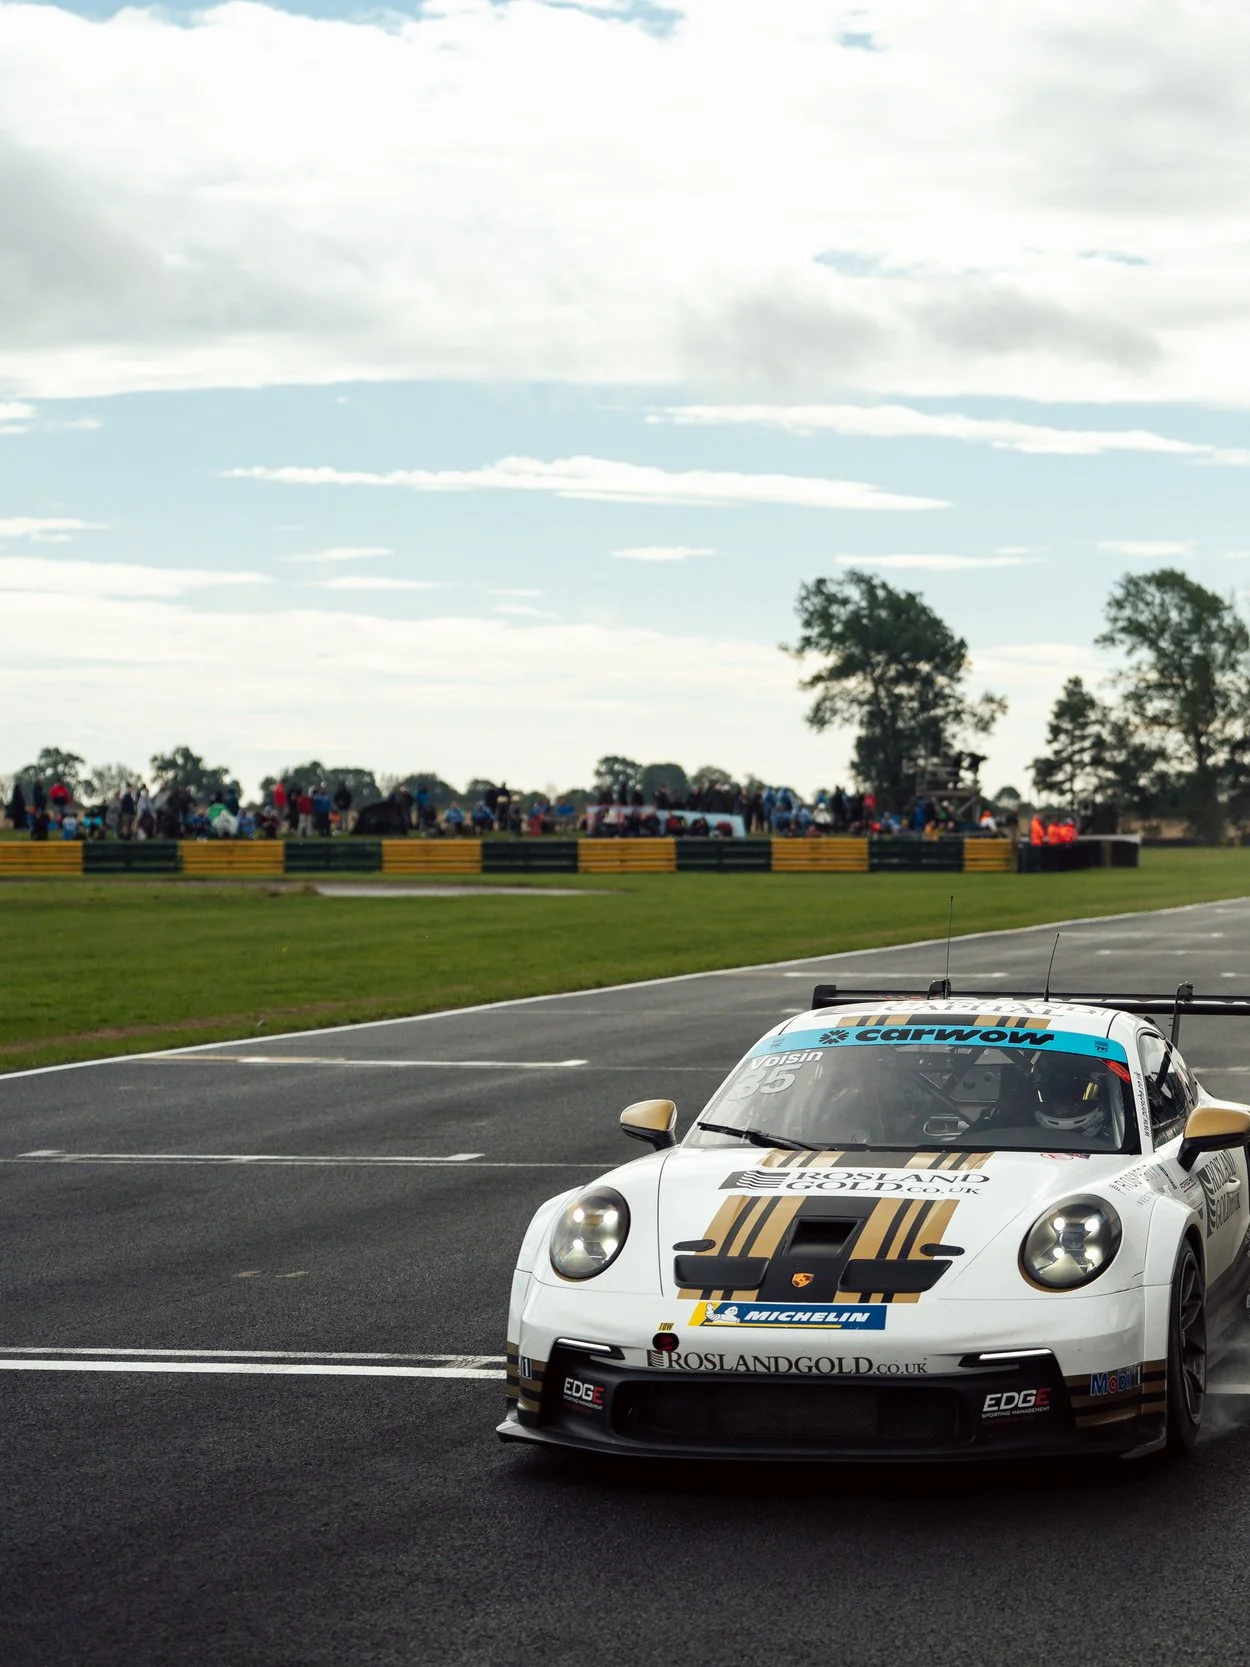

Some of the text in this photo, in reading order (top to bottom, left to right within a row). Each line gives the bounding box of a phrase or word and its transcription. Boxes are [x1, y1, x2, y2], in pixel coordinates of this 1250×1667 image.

[855, 1027, 1055, 1046] carwow
[751, 1049, 824, 1070] Voisin
[794, 1170, 991, 1184] ROSLAND
[743, 1311, 872, 1323] MICHELIN
[563, 1377, 604, 1404] EDGE
[1090, 1367, 1132, 1396] Mobil
[983, 1387, 1051, 1412] EDGE
